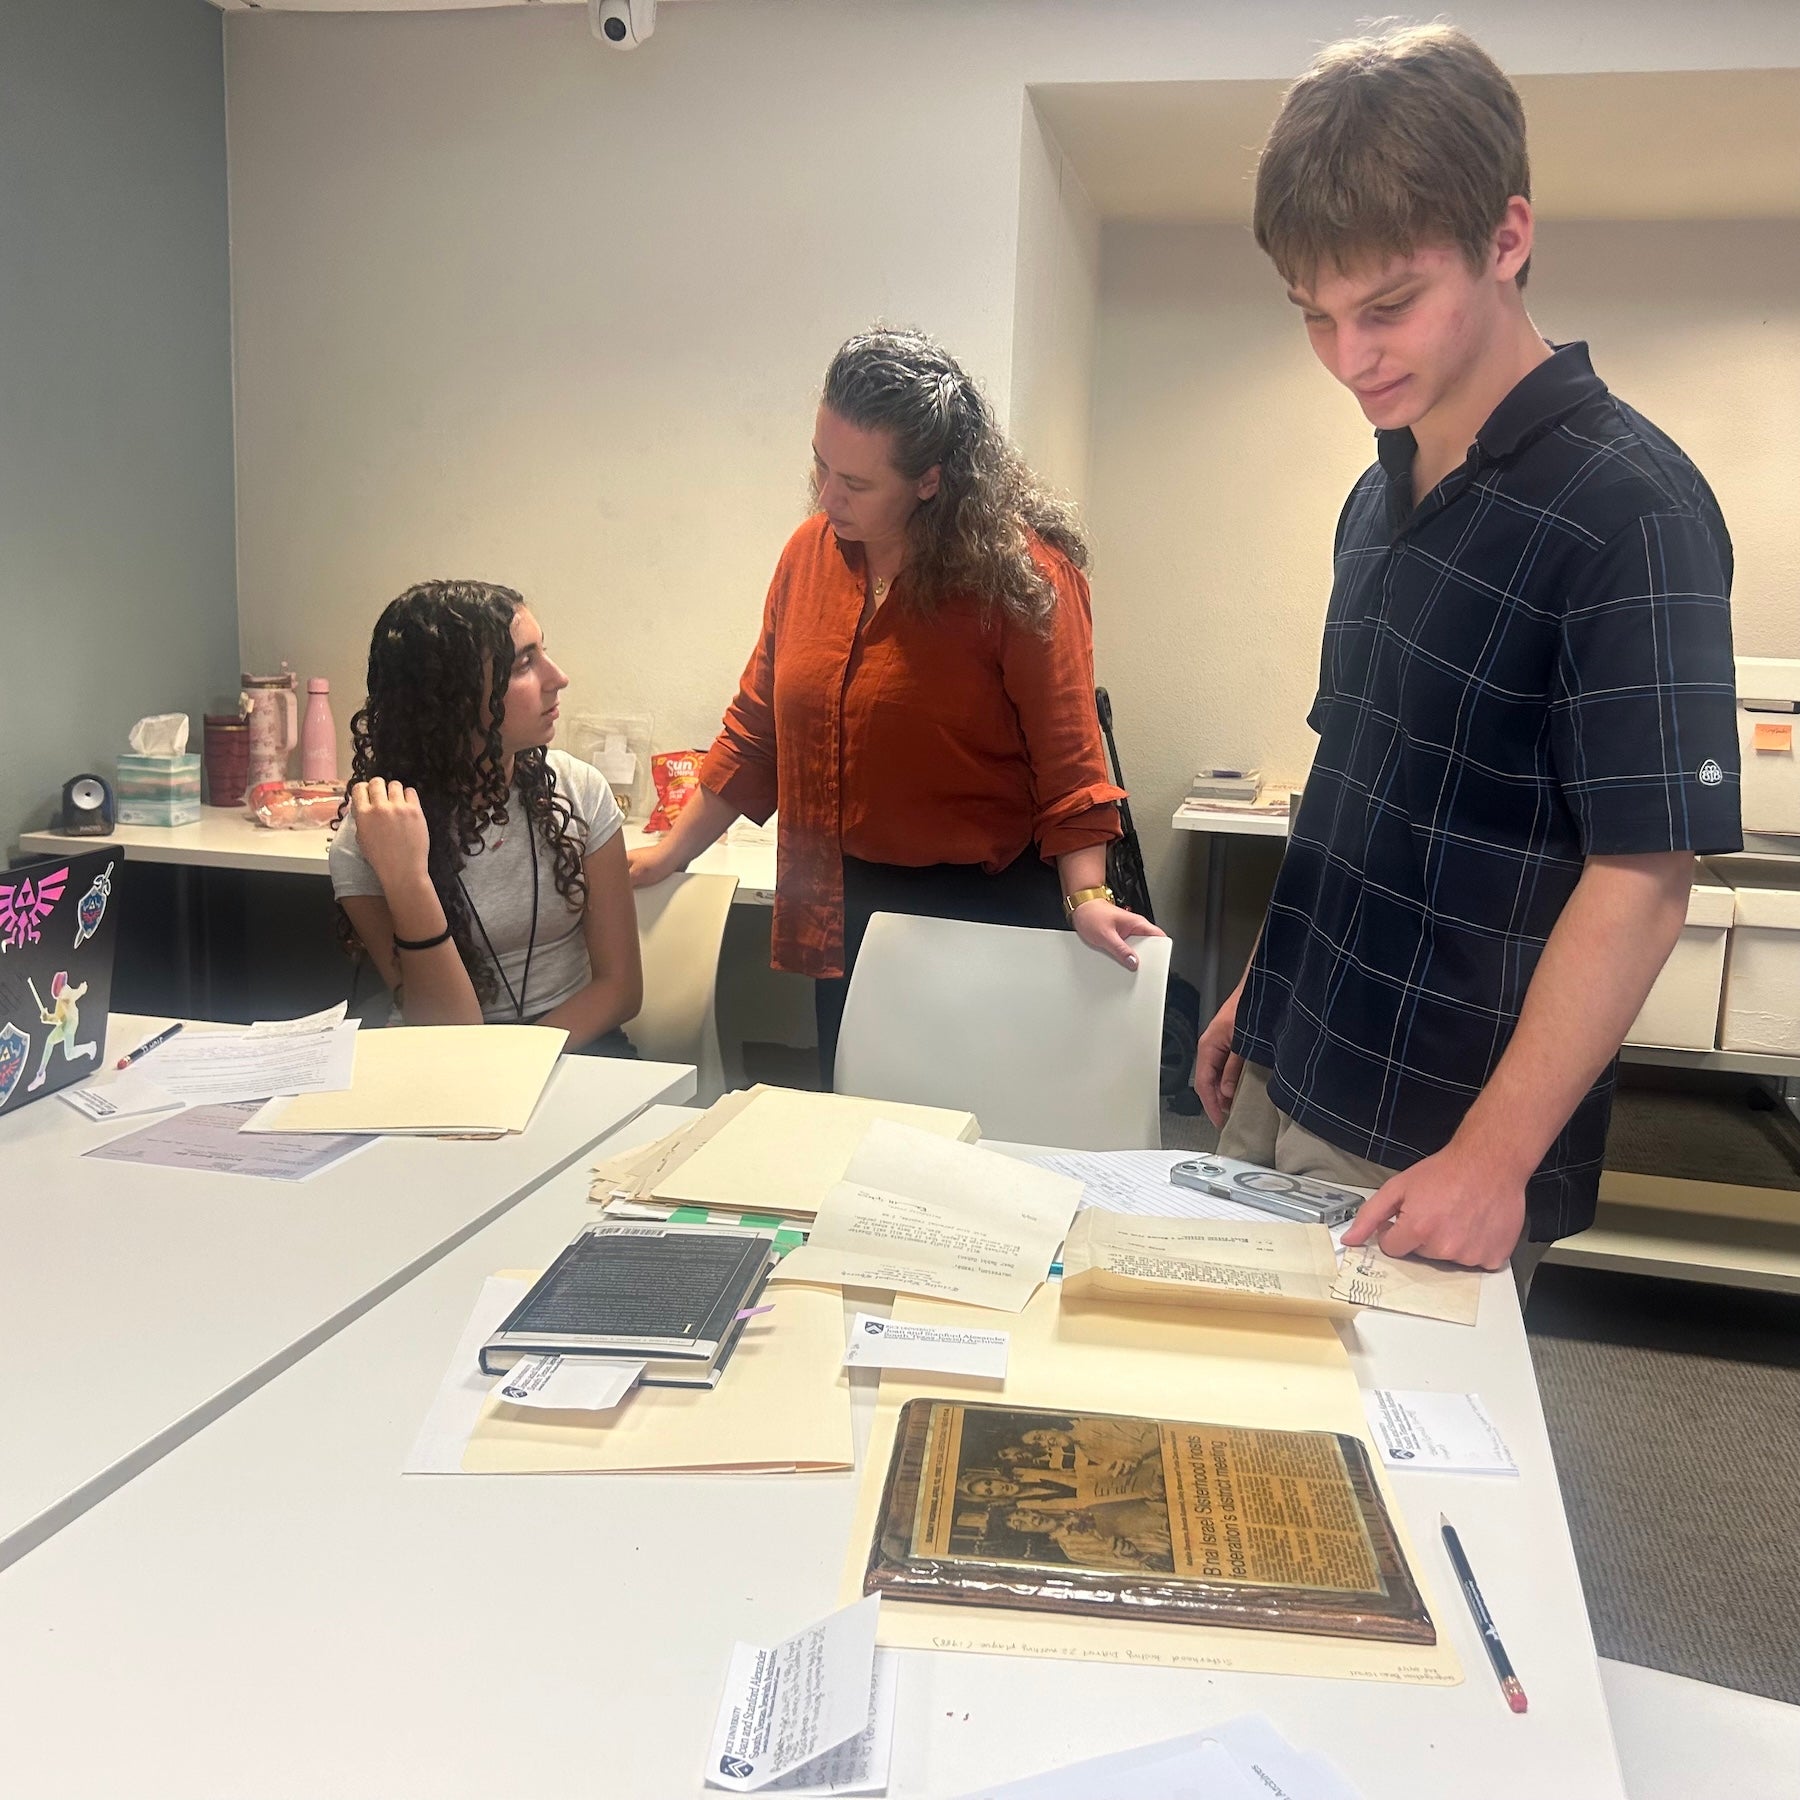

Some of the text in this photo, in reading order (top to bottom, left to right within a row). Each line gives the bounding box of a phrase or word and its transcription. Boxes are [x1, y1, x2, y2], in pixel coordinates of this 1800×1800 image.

[666, 760, 692, 777] Sun
[1188, 1435, 1222, 1577] B'nai Israel Sisterhood hosts
[1209, 1440, 1247, 1578] federation's district meeting
[980, 1642, 1016, 1651] plaque
[735, 1649, 767, 1759] Joan and Stanford Alexander
[748, 1649, 778, 1760] South Texas Jewish Archives
[1250, 1764, 1287, 1797] Archives
